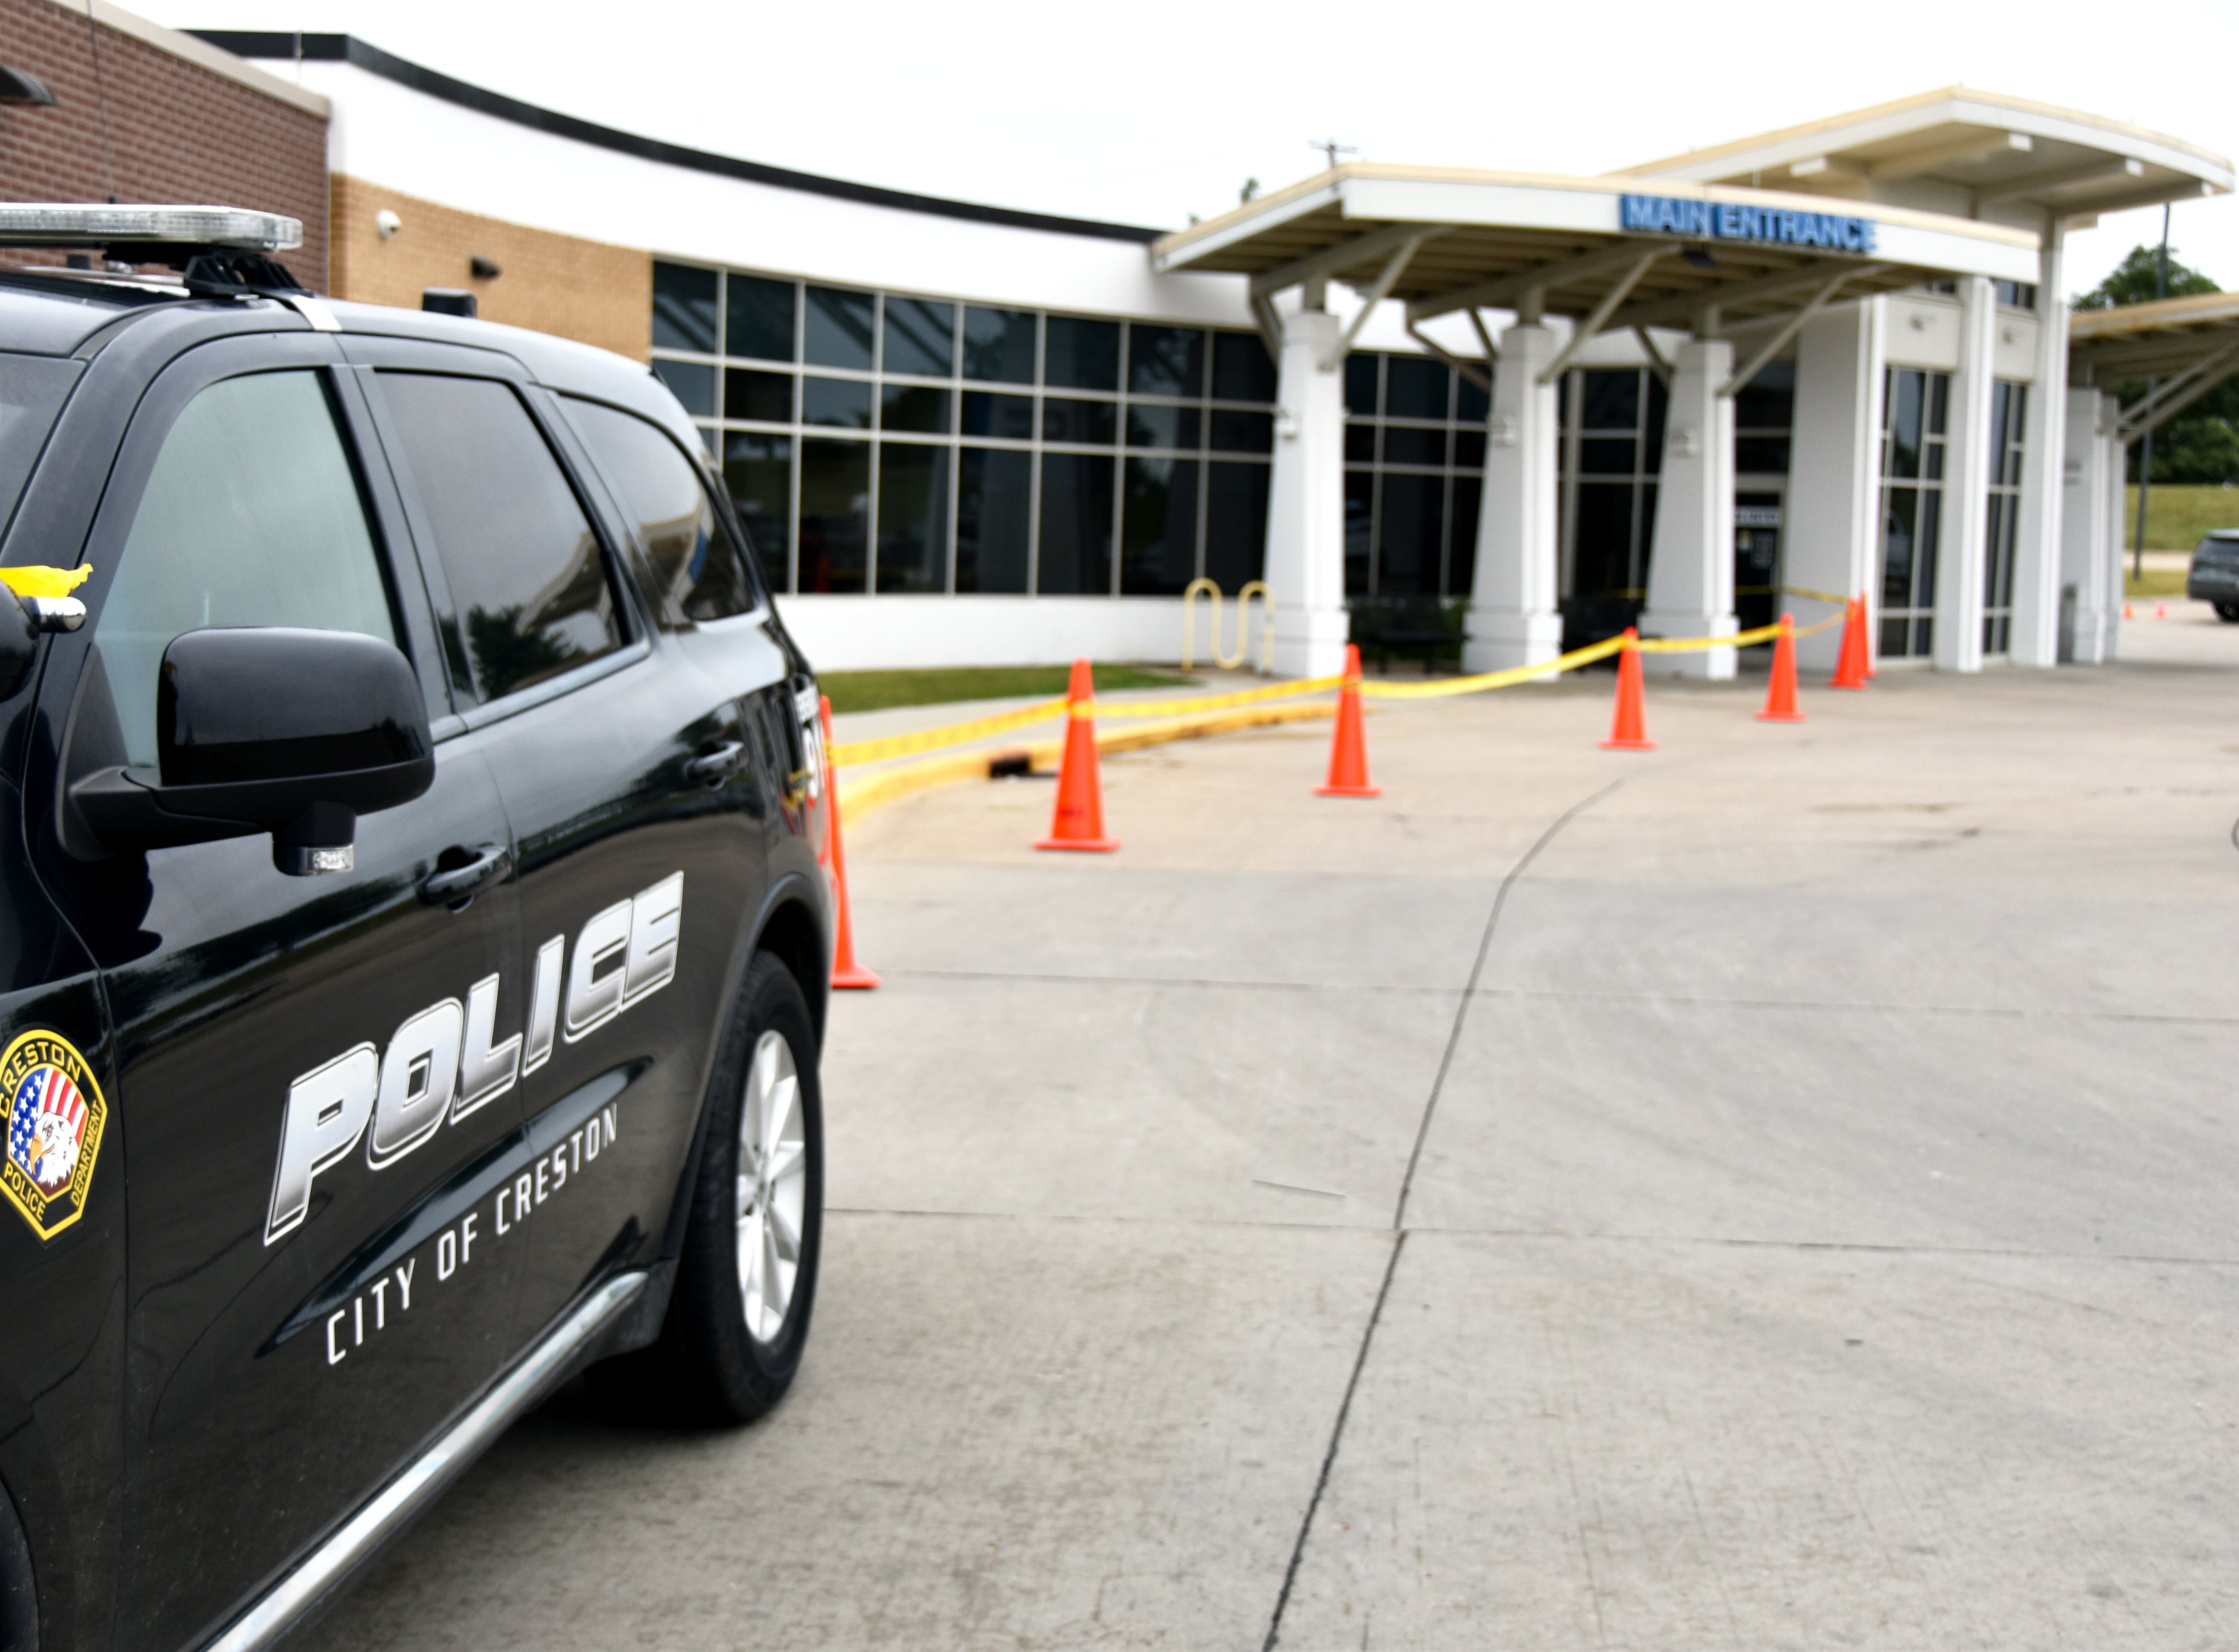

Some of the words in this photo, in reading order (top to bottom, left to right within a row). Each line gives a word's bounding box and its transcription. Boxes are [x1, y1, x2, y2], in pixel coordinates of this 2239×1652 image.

[1621, 194, 1710, 233] MAIN
[1713, 202, 1877, 252] ENTRANCE
[0, 1041, 81, 1118] CRESTON
[263, 870, 684, 1246] POLICE
[4, 1162, 46, 1222] POLICE
[70, 1099, 103, 1206] DEPARTMENT
[327, 1258, 415, 1365] CITY
[438, 1213, 478, 1281] OF
[495, 1102, 618, 1236] CRESTON
